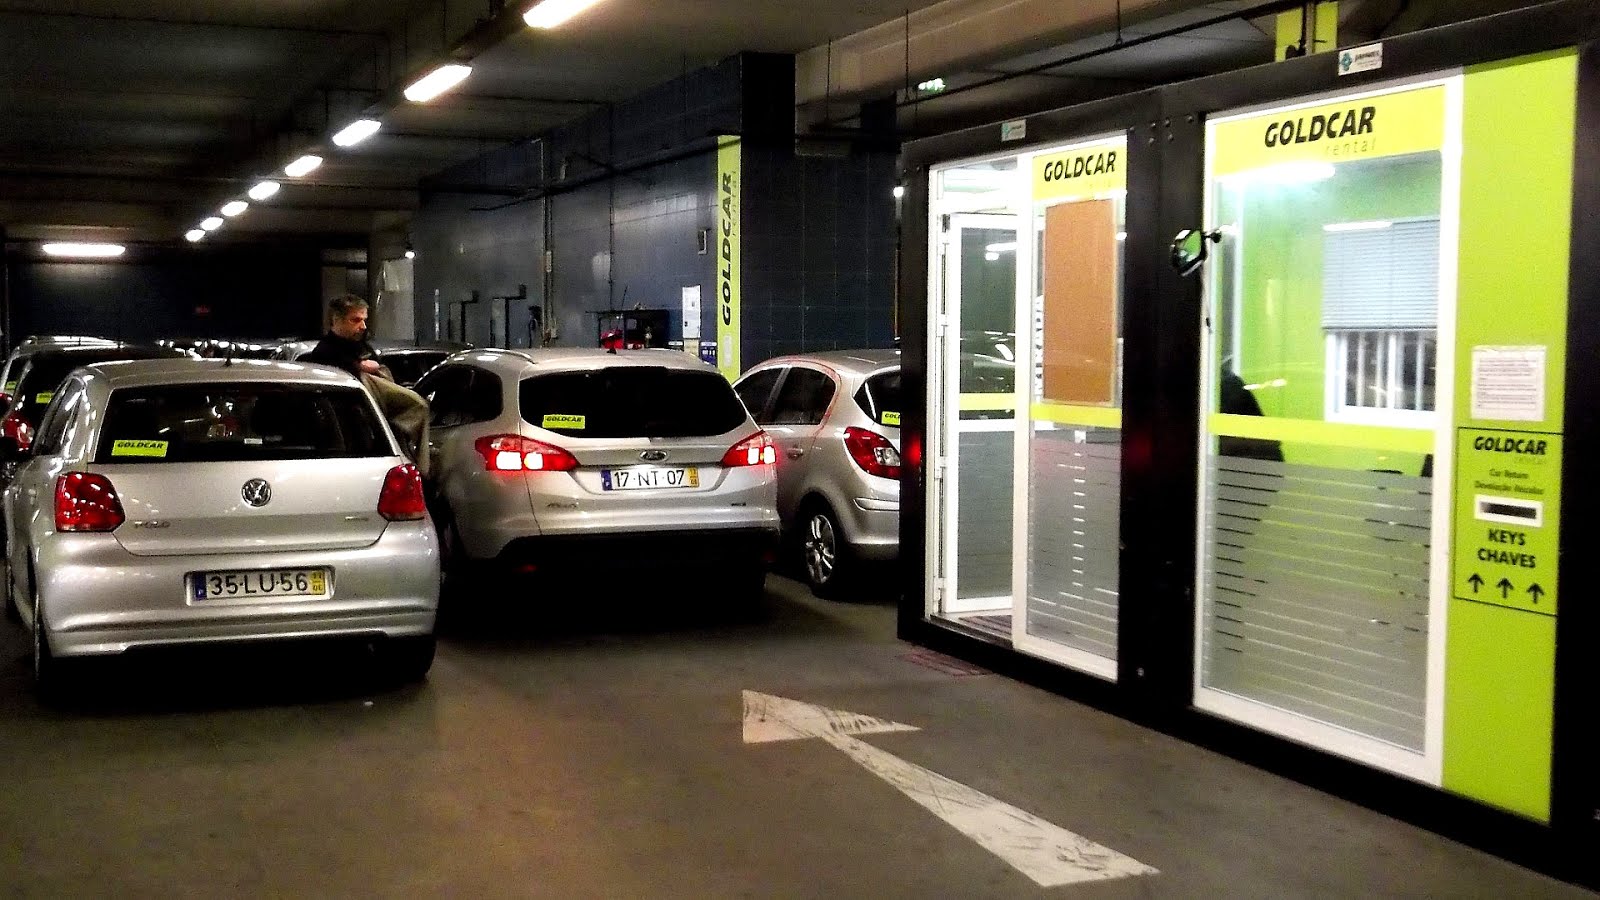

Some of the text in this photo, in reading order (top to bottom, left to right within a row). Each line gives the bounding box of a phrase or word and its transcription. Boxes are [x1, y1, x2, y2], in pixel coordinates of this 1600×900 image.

[1264, 106, 1376, 148] GOLDCAR
[1044, 151, 1117, 182] GOLDCAR
[722, 172, 732, 326] GOLDCAR
[117, 441, 164, 449] GOLDCAR
[1474, 436, 1547, 456] GOLDCAR
[1488, 528, 1526, 546] KEYS
[1477, 547, 1536, 569] CHAVES
